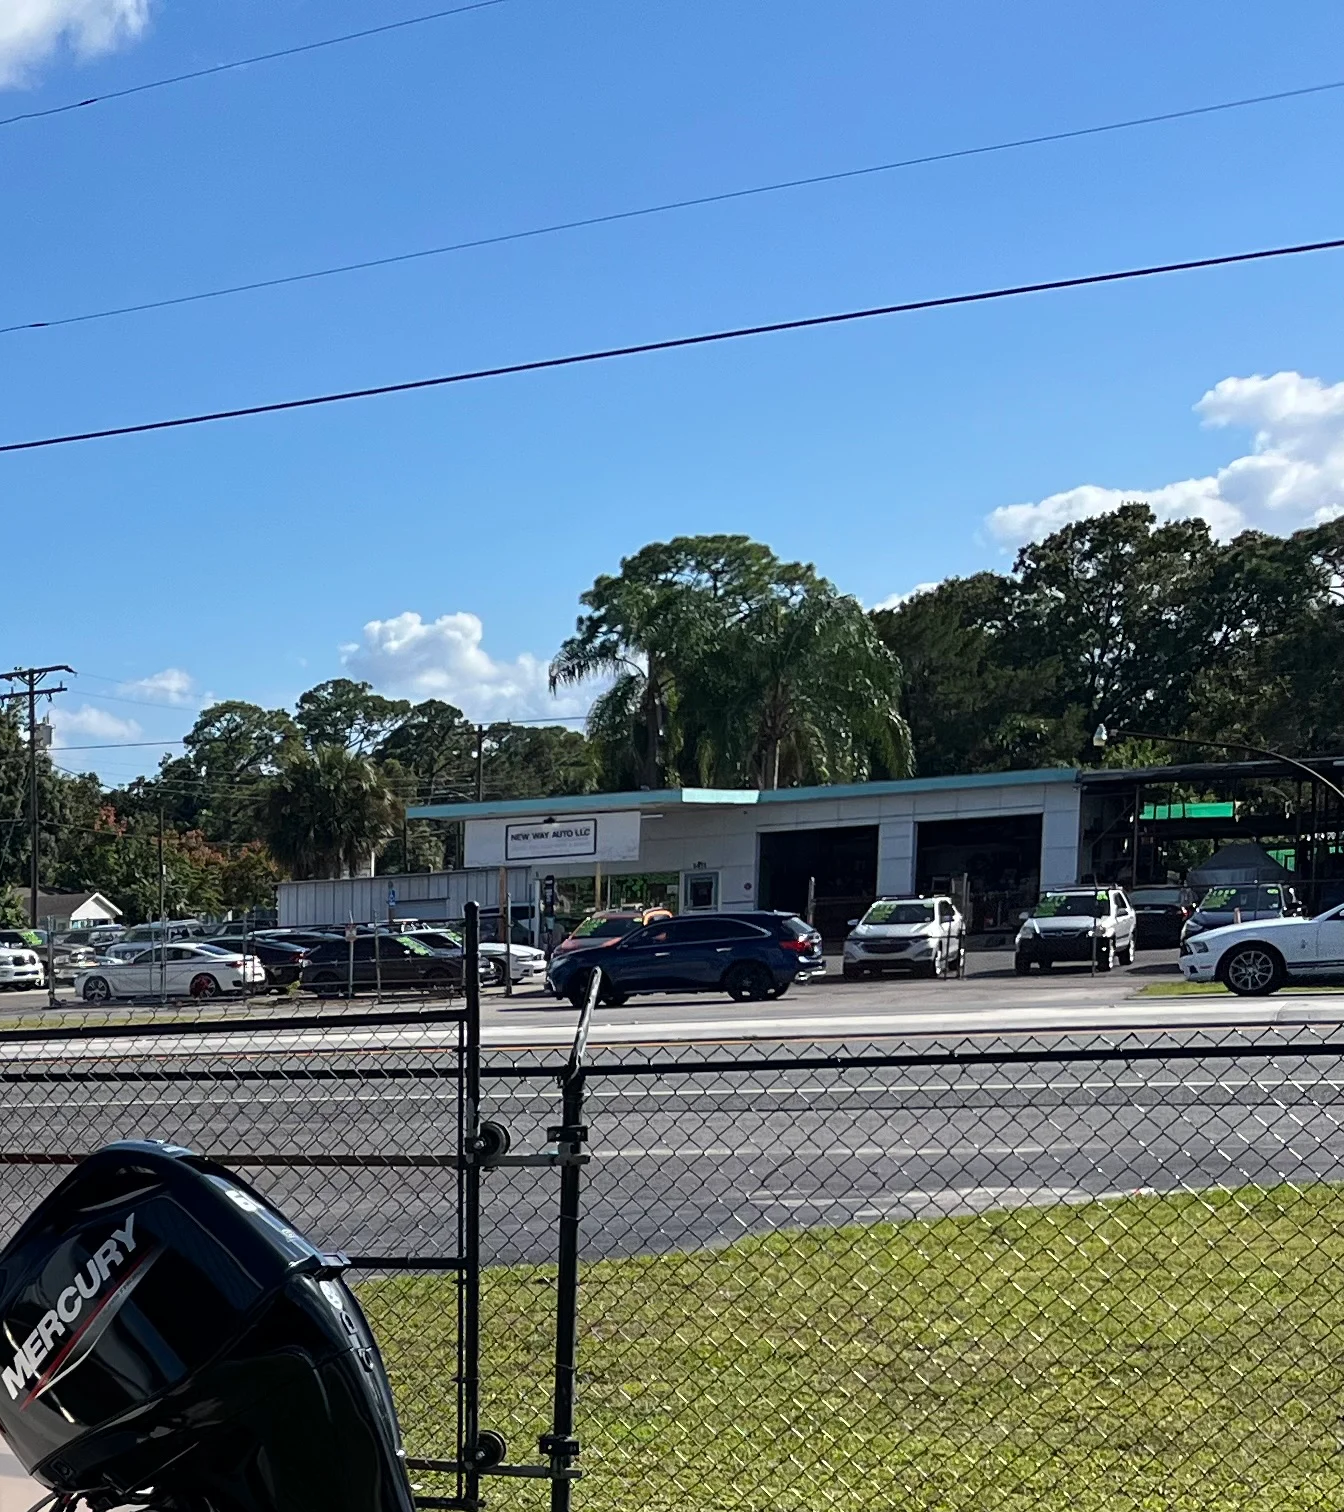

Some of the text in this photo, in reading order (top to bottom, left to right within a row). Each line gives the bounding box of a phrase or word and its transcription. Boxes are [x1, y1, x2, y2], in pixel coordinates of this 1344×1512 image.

[511, 828, 590, 841] NEW WAY AUTO LLC
[0, 1212, 137, 1400] MERCURY
